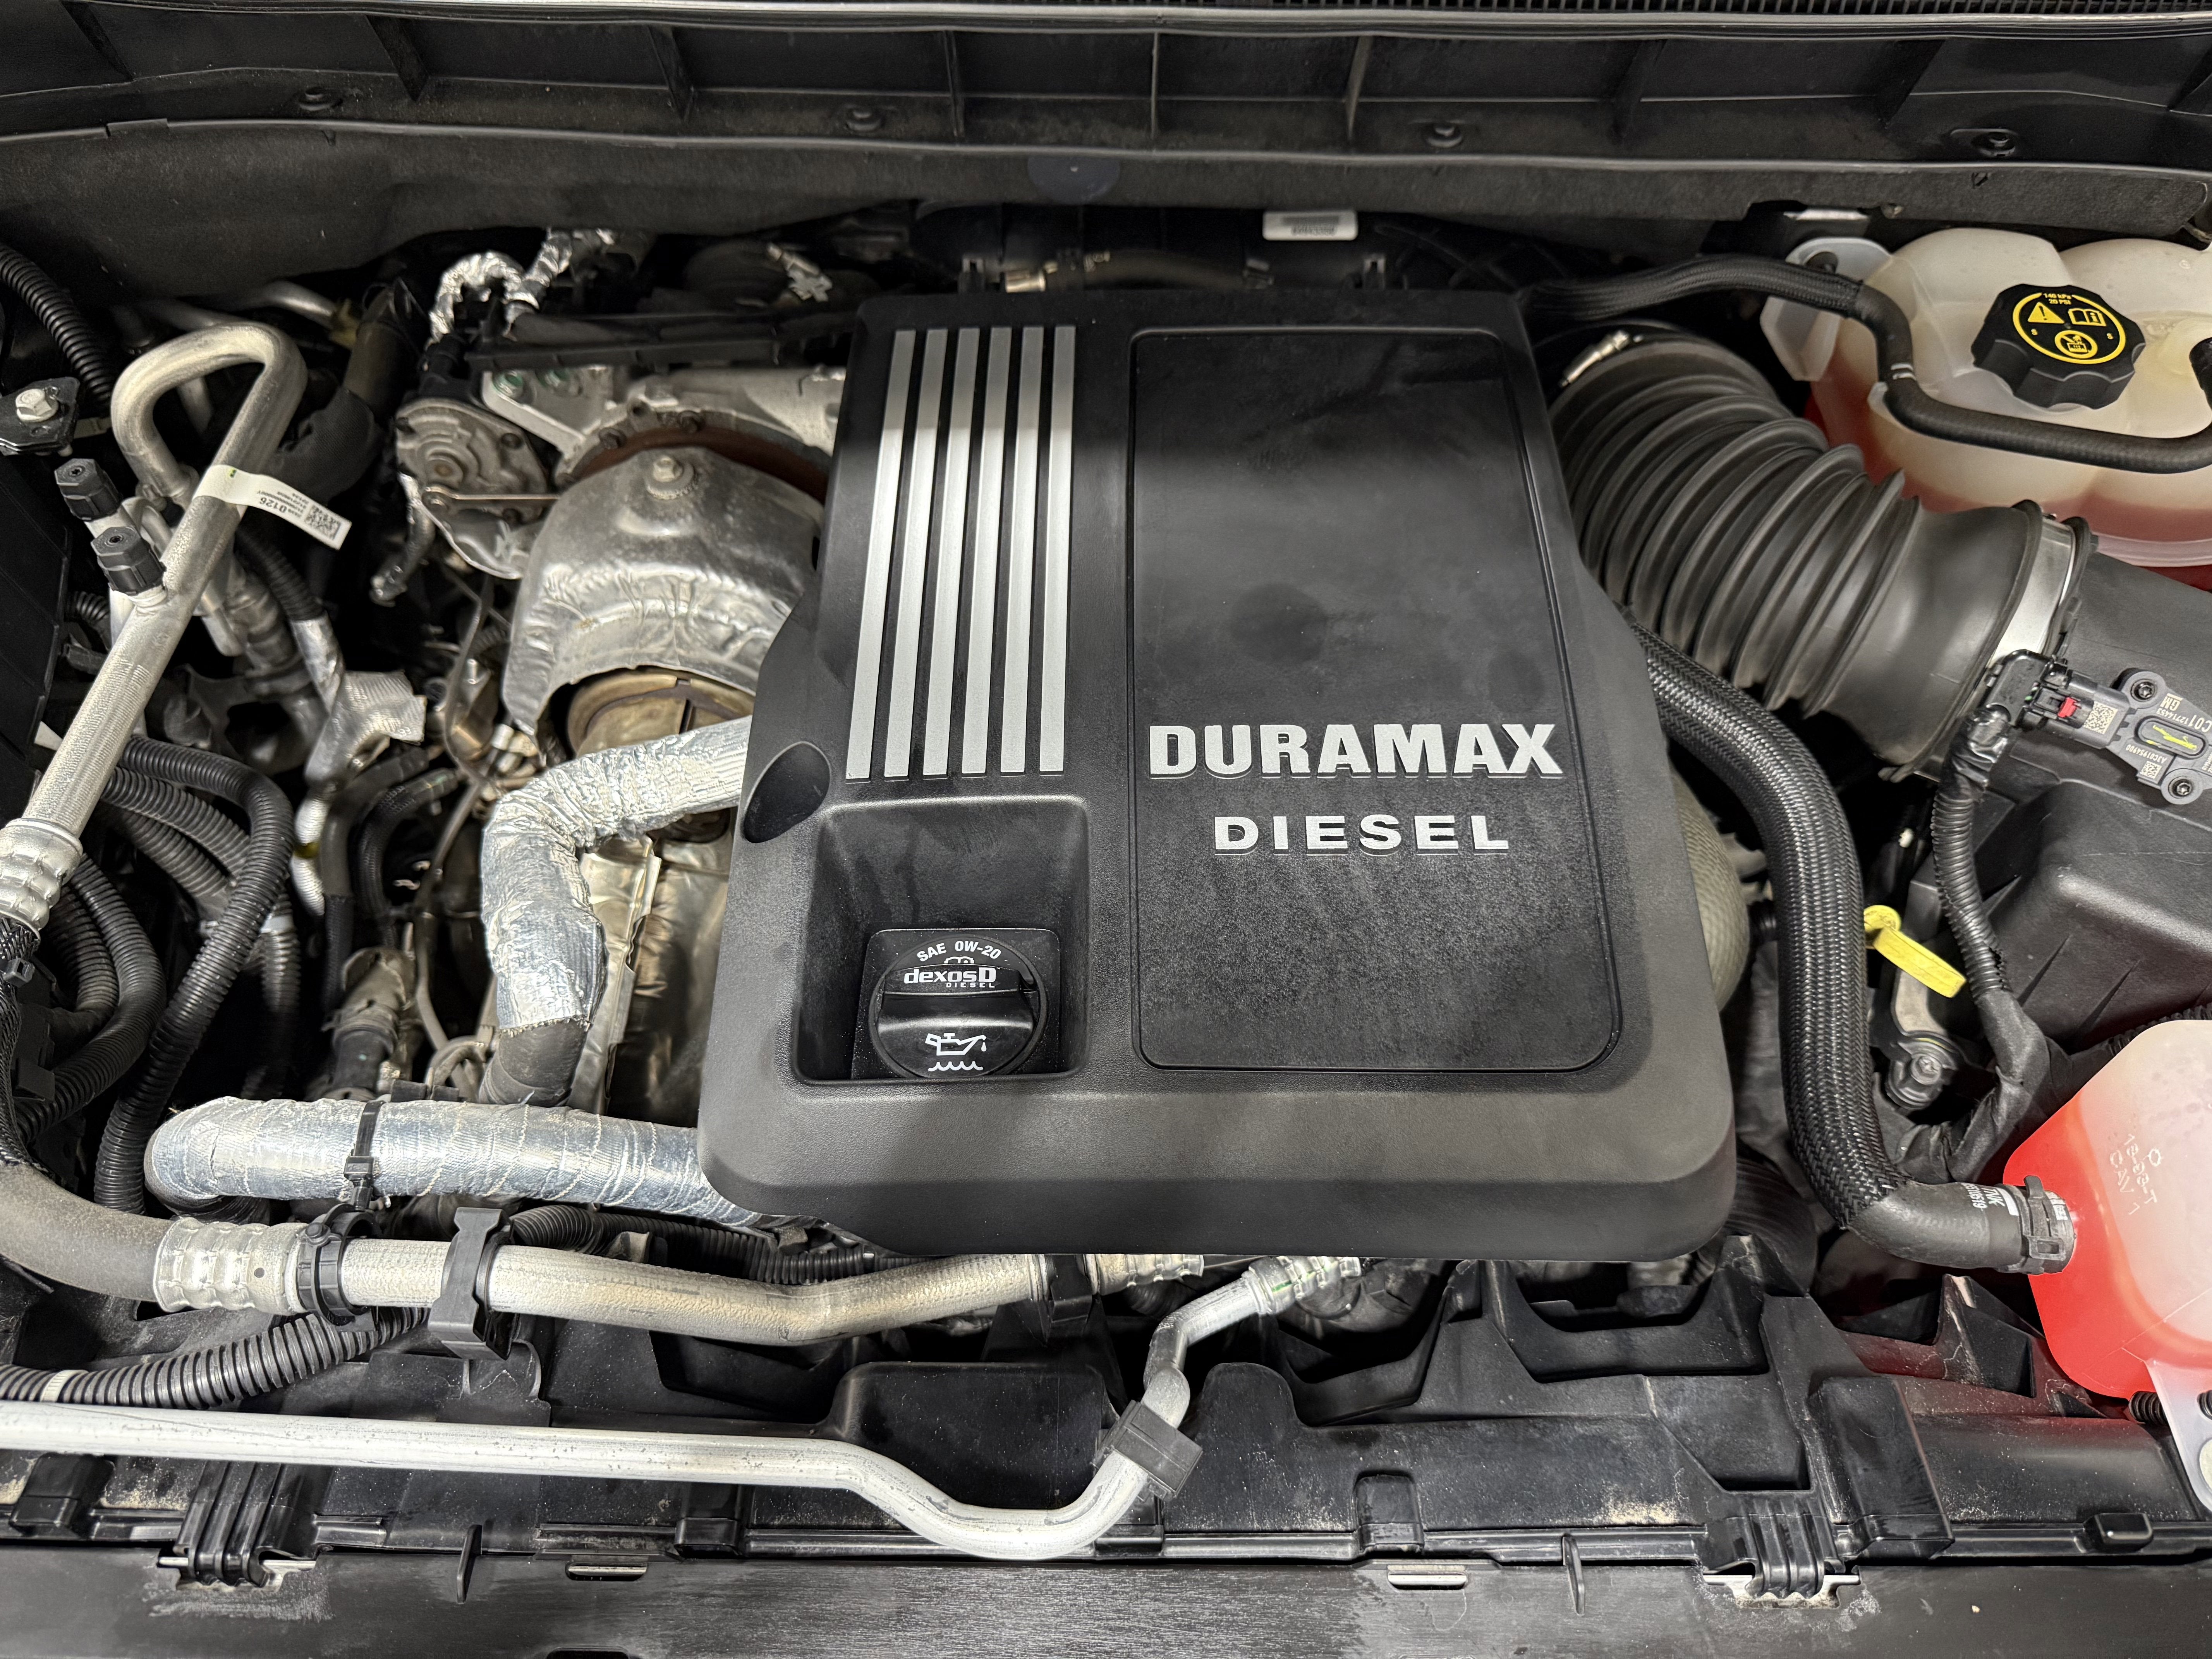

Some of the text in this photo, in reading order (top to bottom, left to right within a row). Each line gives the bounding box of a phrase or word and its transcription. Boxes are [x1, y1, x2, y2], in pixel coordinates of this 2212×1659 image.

[259, 497, 287, 513] 0126
[2160, 696, 2181, 711] GM
[2156, 708, 2212, 733] C01 12714453
[1149, 723, 1563, 778] DURAMAX
[1214, 814, 1509, 855] DIESEL
[917, 940, 1001, 962] SAE 0W-20
[904, 967, 996, 984] dexosD
